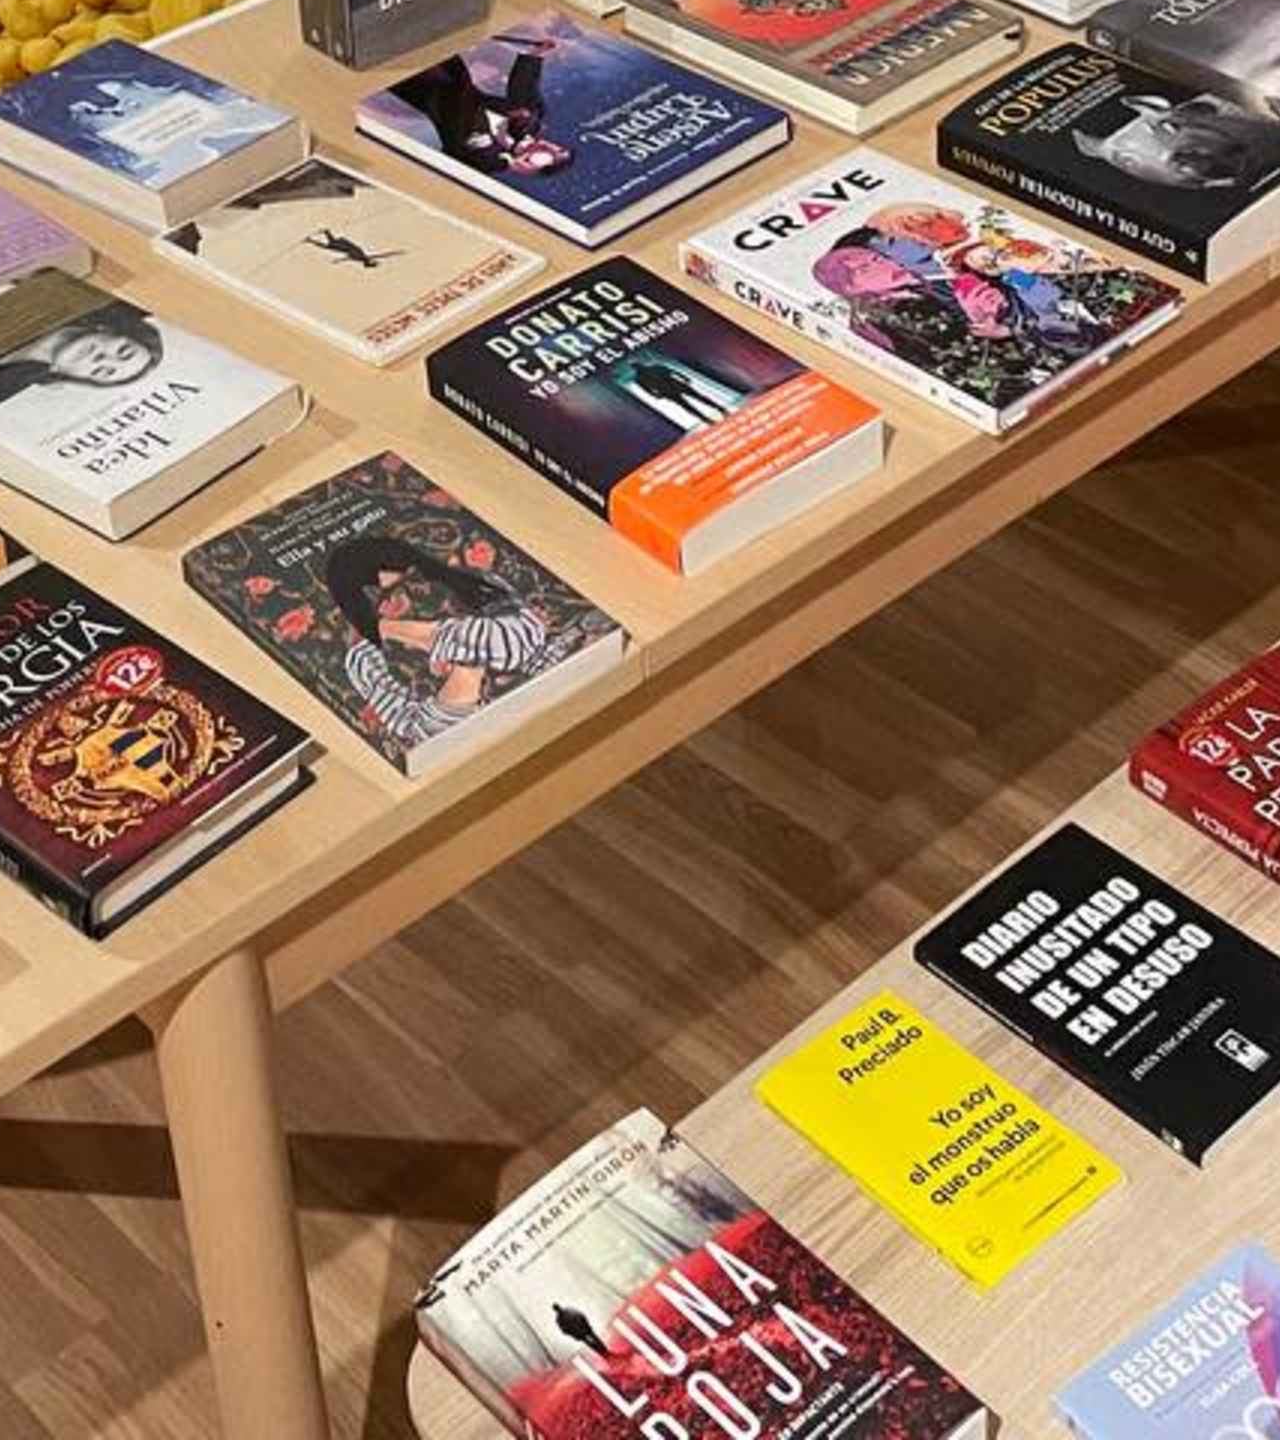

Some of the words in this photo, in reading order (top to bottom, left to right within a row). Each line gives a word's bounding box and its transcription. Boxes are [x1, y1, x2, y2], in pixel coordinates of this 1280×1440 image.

[979, 53, 1118, 138] POPULUS
[734, 167, 884, 252] CRAVE
[485, 280, 626, 361] DONATO
[506, 294, 669, 385] CARRISI
[734, 279, 806, 331] CRAVE
[527, 378, 560, 402] YO
[558, 357, 598, 388] SOY
[595, 341, 624, 365] EL
[623, 310, 691, 354] ABISMO
[55, 379, 201, 461] Vilariño
[84, 428, 173, 477] Idea
[276, 544, 313, 569] Ella
[35, 598, 90, 642] LOS
[960, 889, 1062, 969] DIARIO
[995, 876, 1142, 994] INUSITADO
[1029, 980, 1083, 1021] DE
[1065, 947, 1121, 990] UN
[1104, 898, 1178, 956] TIPO
[1065, 1006, 1119, 1047] EN
[1101, 922, 1214, 1017] DESUSO
[837, 1024, 924, 1086] Preciado
[839, 1017, 887, 1052] Paul
[907, 1162, 934, 1187] el
[927, 1101, 1019, 1174] monstruo
[928, 1103, 963, 1130] Yo
[958, 1082, 998, 1114] soy
[929, 1171, 971, 1207] que
[966, 1153, 995, 1180] os
[987, 1116, 1042, 1161] habla
[463, 1237, 526, 1298] MARTA
[572, 1239, 779, 1419] LUNA
[1109, 1278, 1243, 1386] RESISTENCIA
[1124, 1296, 1266, 1411] BISEXUAL
